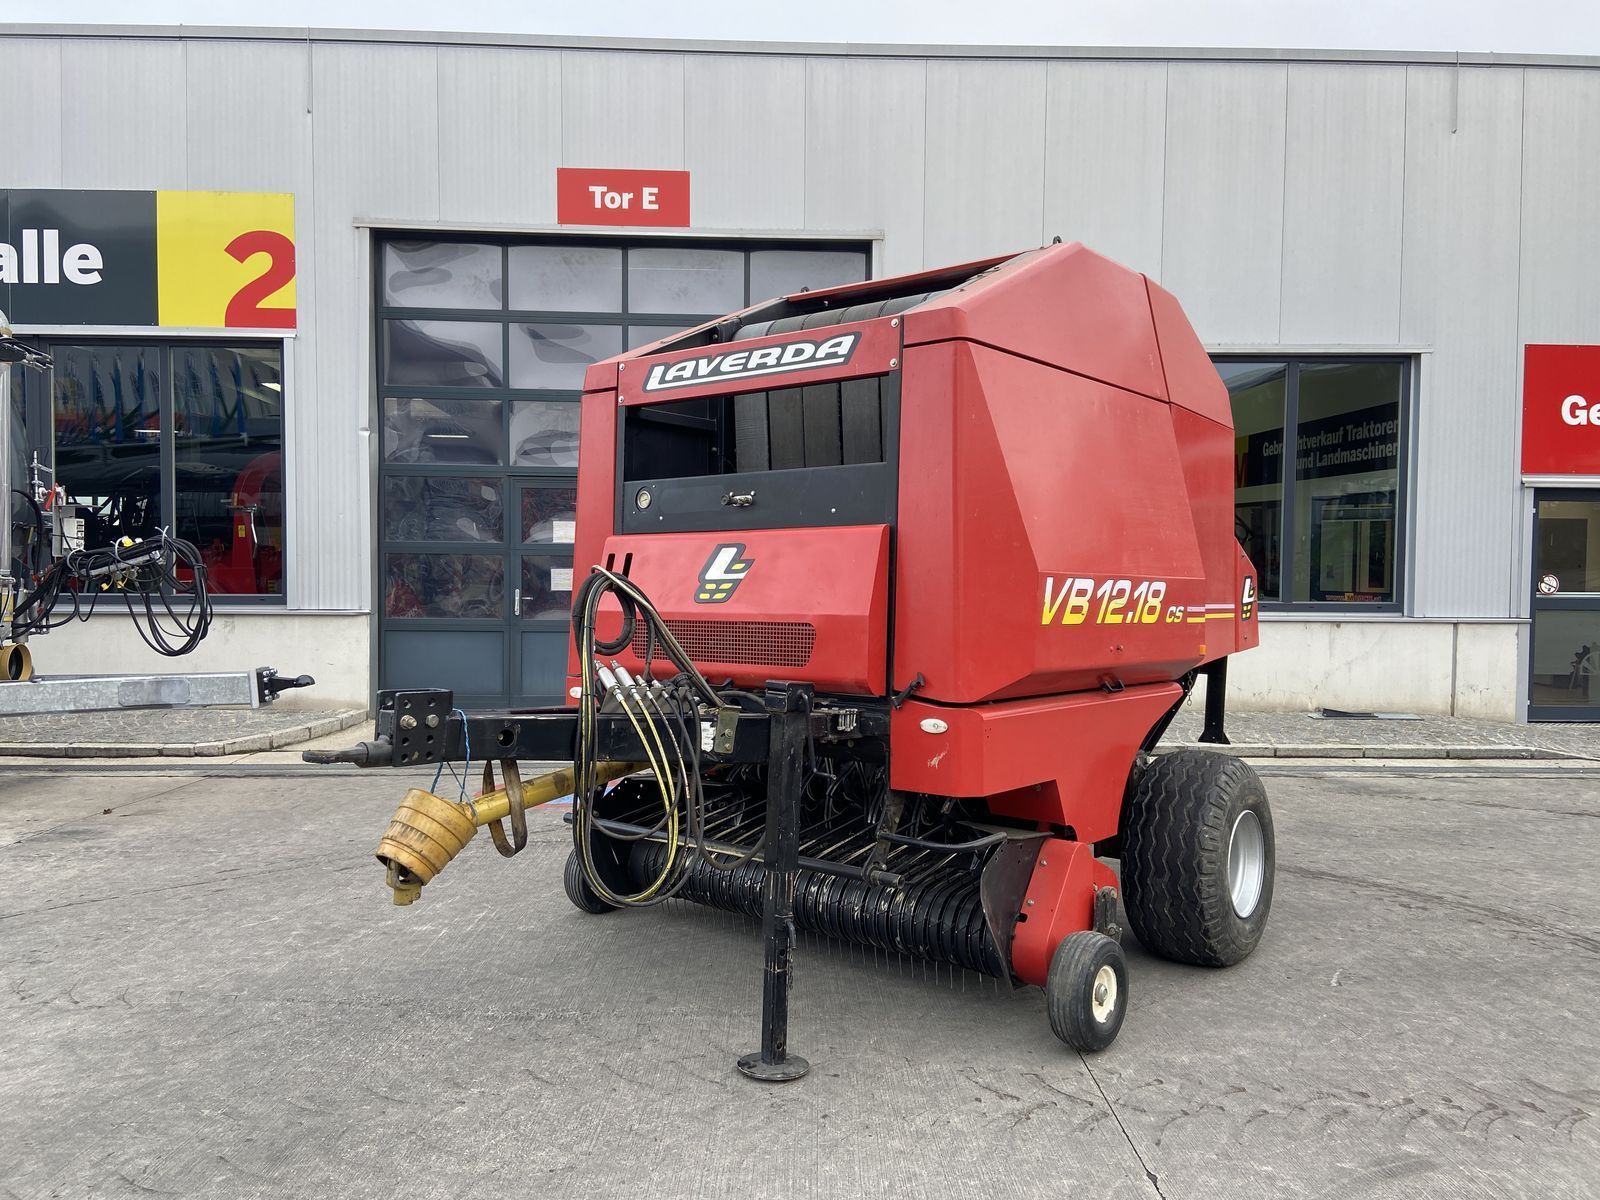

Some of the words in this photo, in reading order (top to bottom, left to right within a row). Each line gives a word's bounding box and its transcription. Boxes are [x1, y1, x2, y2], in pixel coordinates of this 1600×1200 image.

[588, 185, 634, 209] Tor
[642, 186, 659, 210] E
[223, 230, 297, 328] 2
[646, 334, 856, 391] LAVERDA
